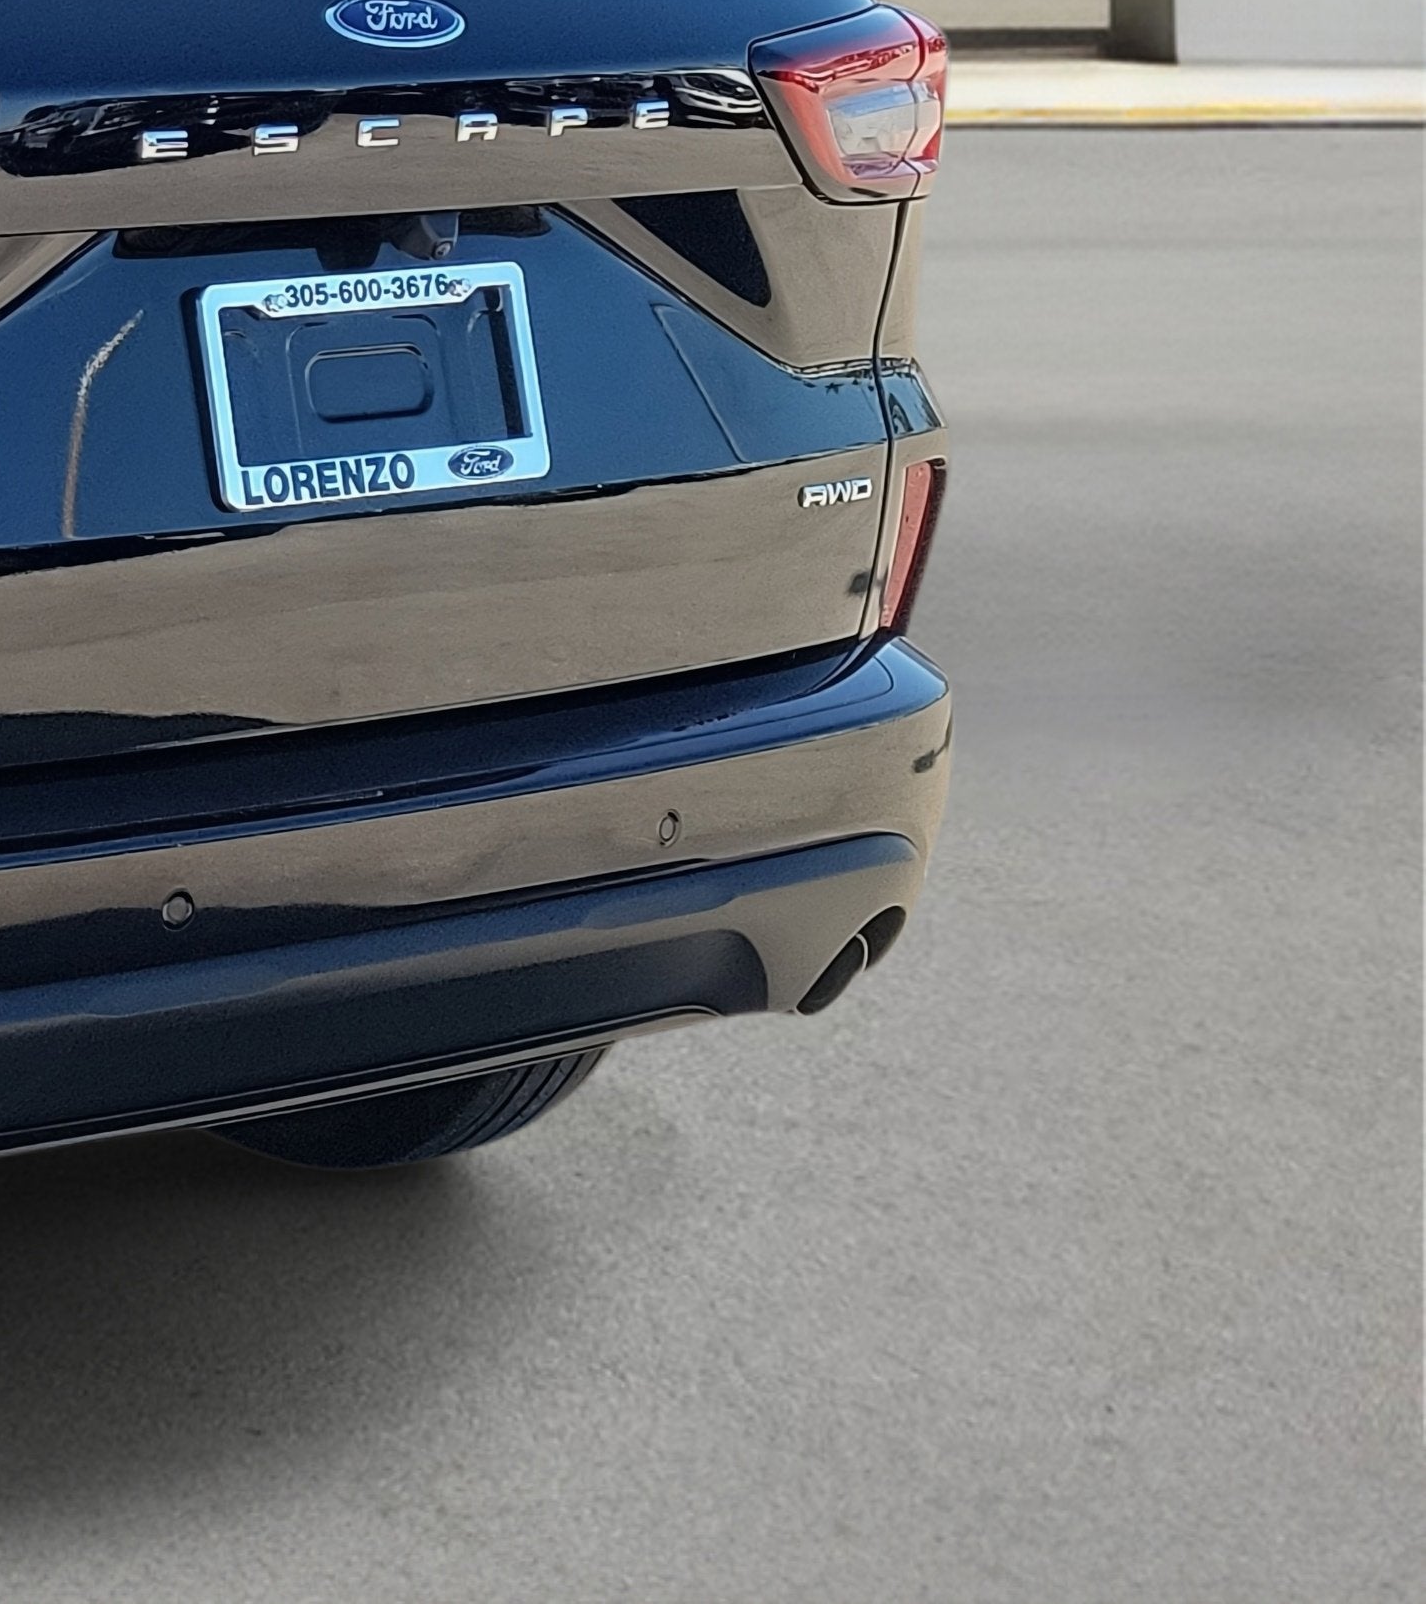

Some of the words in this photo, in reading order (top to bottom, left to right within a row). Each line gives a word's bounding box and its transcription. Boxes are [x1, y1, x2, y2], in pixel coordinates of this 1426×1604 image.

[364, 0, 439, 31] Ford
[141, 100, 669, 158] ESCAPE
[285, 273, 449, 308] 305-600-3676
[241, 453, 415, 506] LORENZO
[460, 449, 503, 473] Ford
[801, 478, 873, 508] AWD
